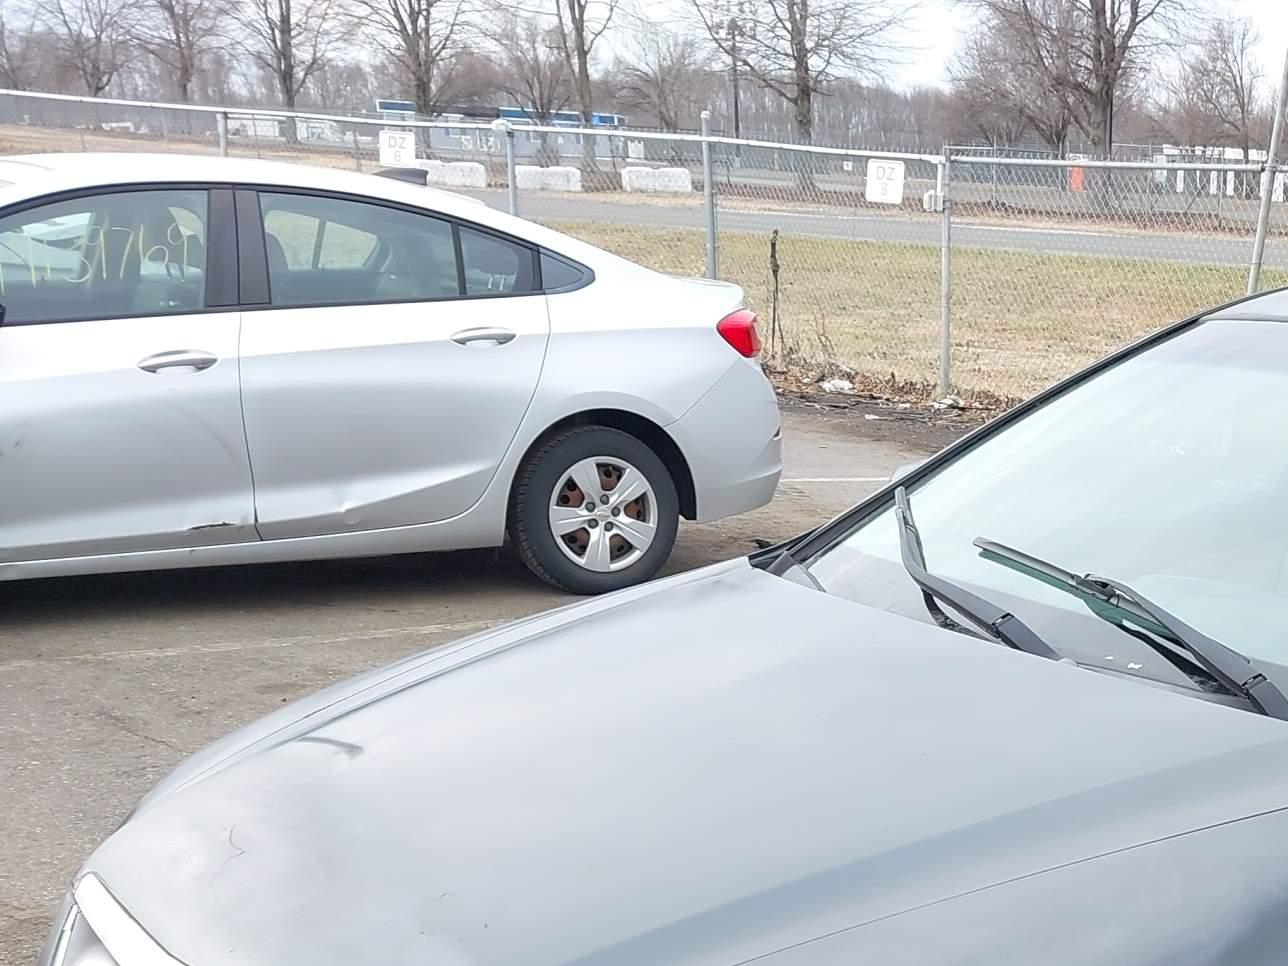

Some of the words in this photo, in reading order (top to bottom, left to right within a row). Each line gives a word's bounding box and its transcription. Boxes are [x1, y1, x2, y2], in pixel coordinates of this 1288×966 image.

[388, 136, 407, 149] DZ
[876, 166, 896, 181] DZ
[880, 182, 888, 196] 8
